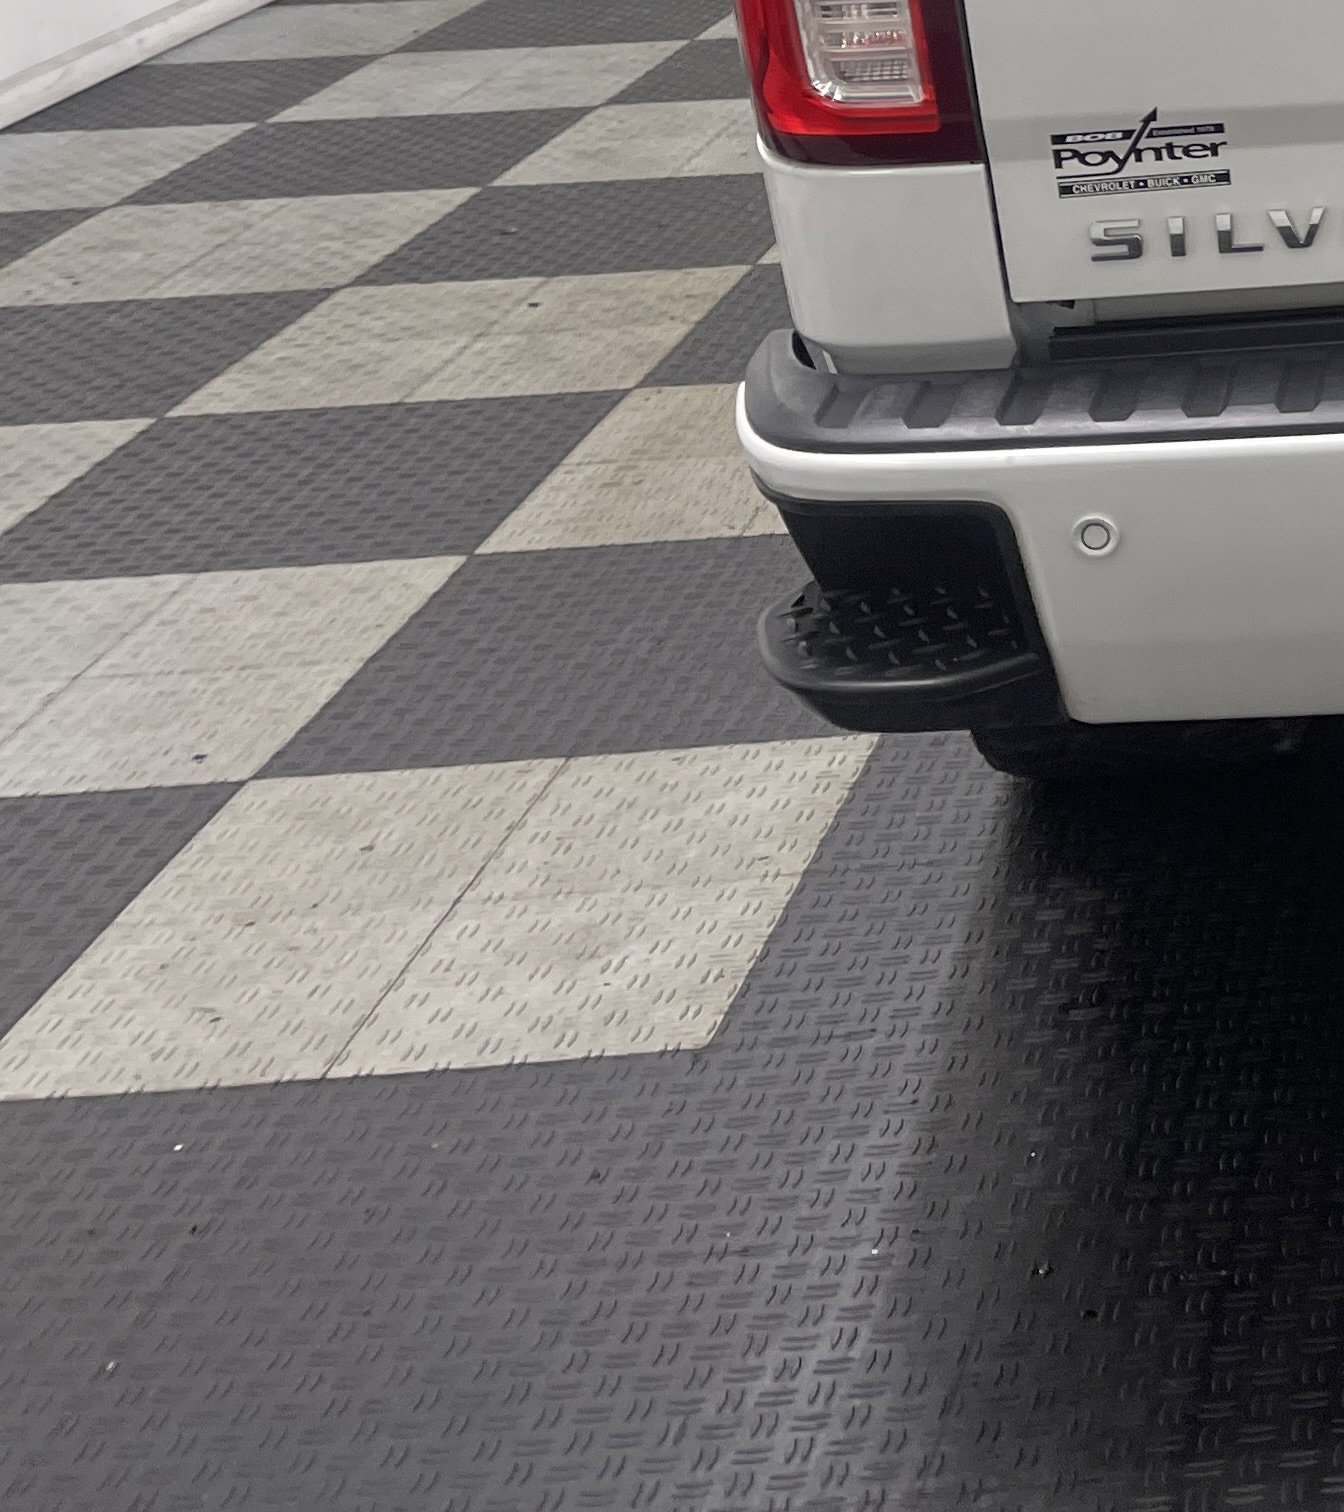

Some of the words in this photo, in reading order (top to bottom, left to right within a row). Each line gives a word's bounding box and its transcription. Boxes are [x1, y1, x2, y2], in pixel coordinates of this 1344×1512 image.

[1065, 131, 1124, 144] BOB
[1052, 140, 1228, 174] Poynter
[1072, 179, 1136, 194] CHEVROLET
[1147, 176, 1181, 188] BUICK
[1191, 173, 1217, 184] GMC
